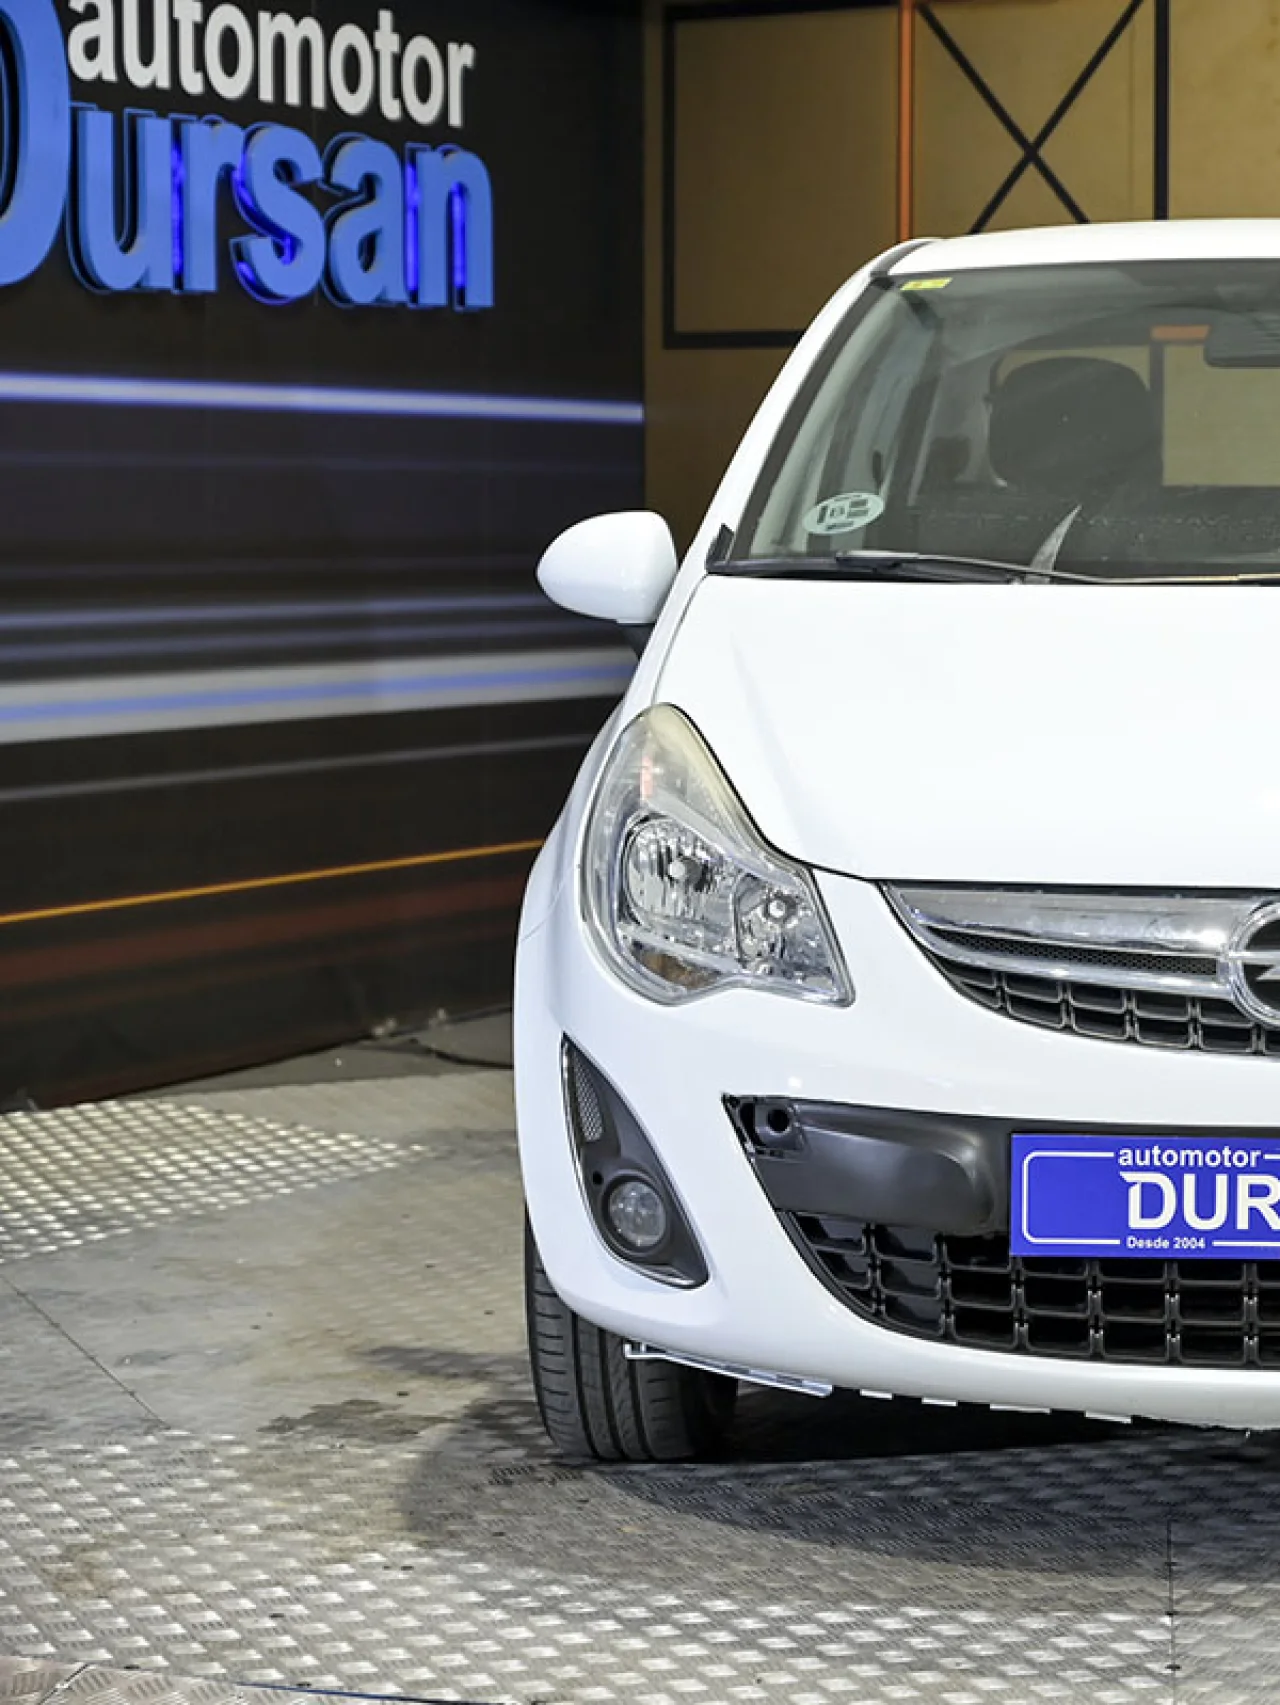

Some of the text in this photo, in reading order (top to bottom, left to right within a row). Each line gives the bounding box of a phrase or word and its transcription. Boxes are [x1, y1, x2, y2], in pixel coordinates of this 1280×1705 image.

[67, 0, 476, 127] automotor
[1118, 1145, 1261, 1168] automotor
[1126, 1235, 1206, 1249] Desde 2004
